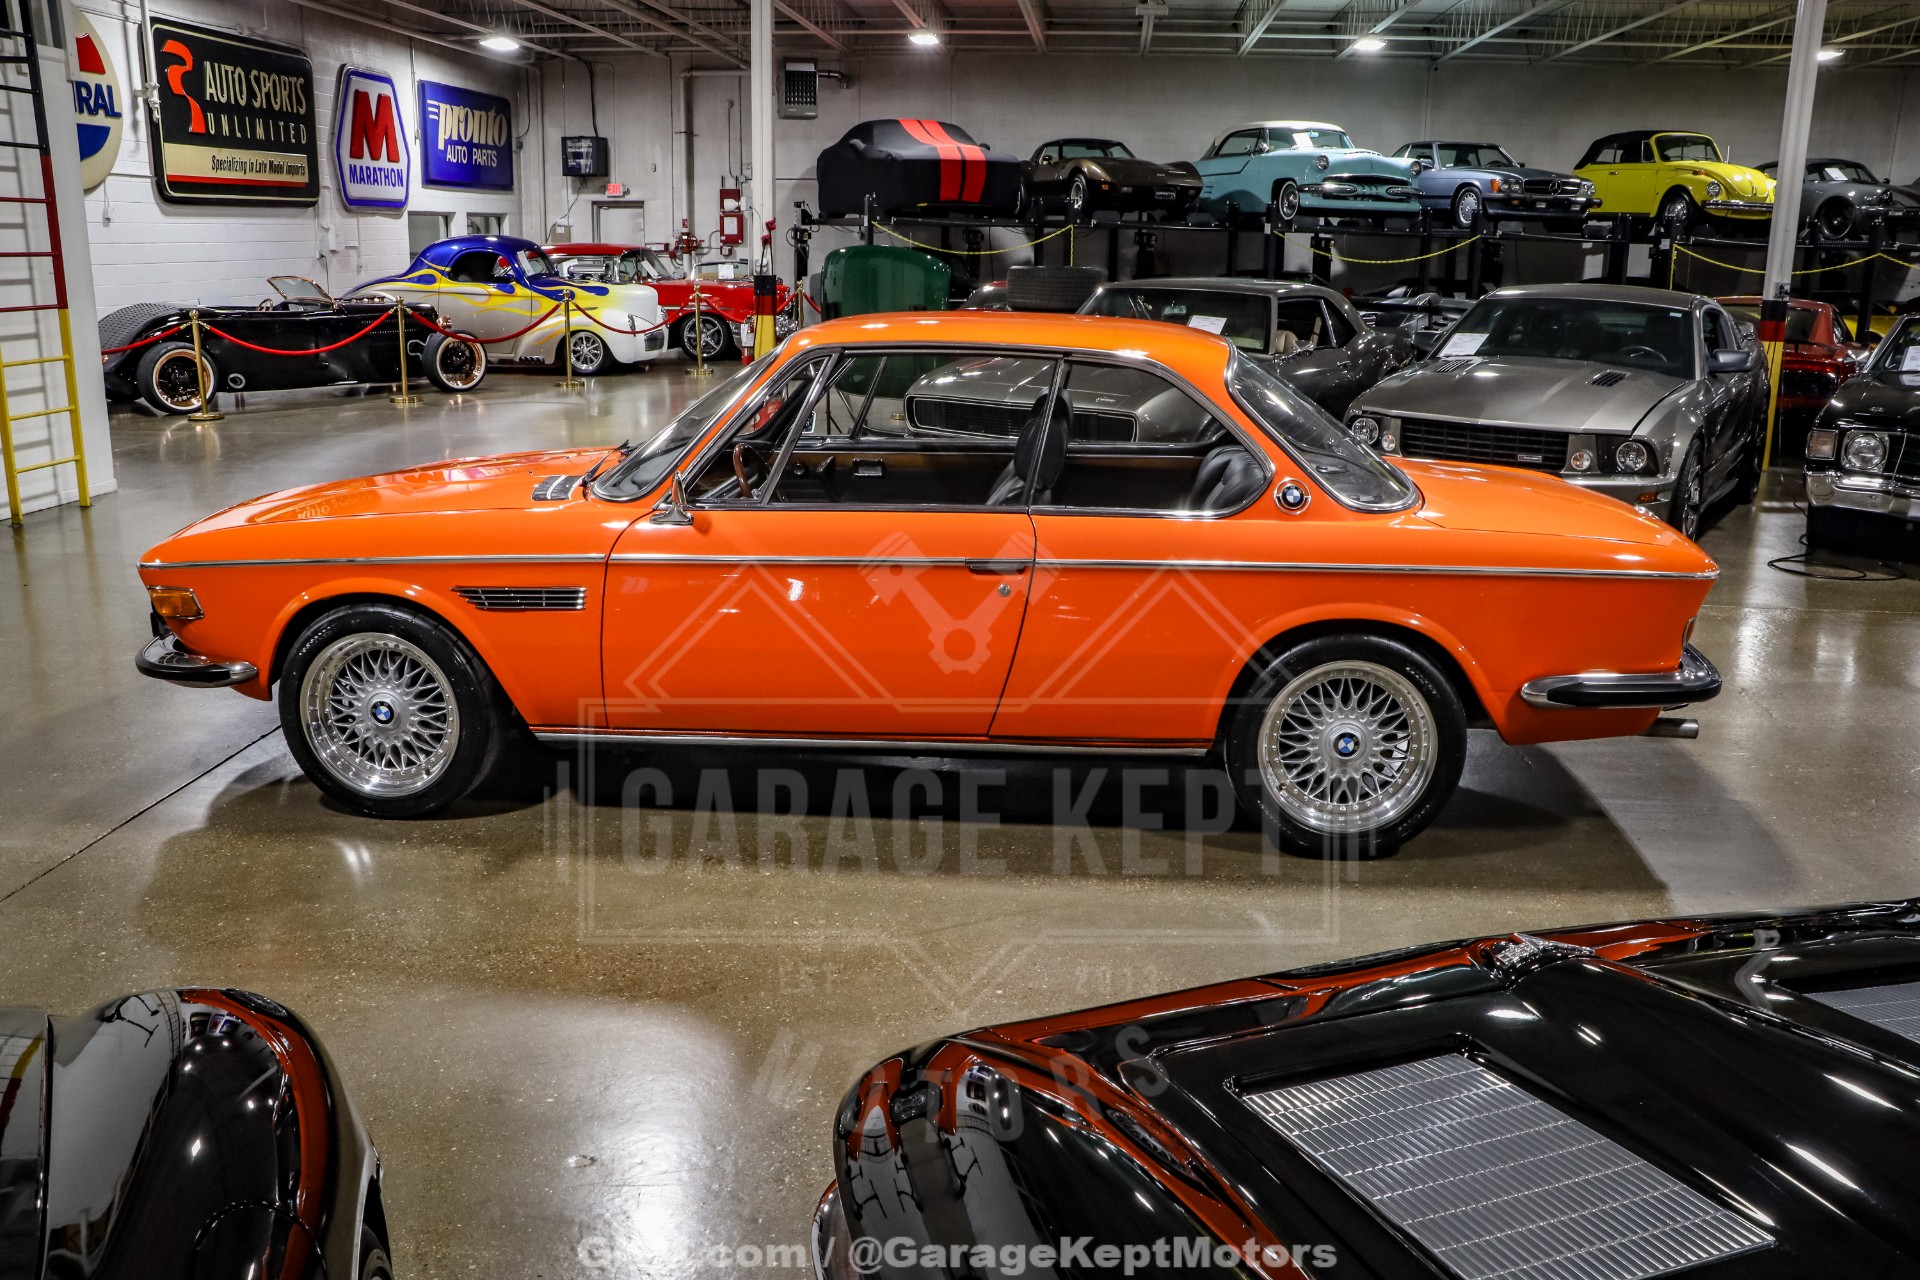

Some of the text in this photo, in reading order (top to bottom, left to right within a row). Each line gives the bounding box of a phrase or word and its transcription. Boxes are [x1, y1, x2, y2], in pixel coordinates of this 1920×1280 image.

[71, 80, 122, 118] RAL
[204, 60, 307, 115] AUTO SPORTS
[207, 112, 307, 145] UNLIMITED
[436, 101, 508, 150] pronto
[211, 155, 247, 175] Specializing
[255, 159, 267, 173] Late
[269, 159, 284, 174] Model
[285, 160, 306, 177] Imports
[446, 144, 498, 168] AUTO PARTS
[349, 164, 404, 188] MARATHON
[607, 183, 621, 195] EXIT
